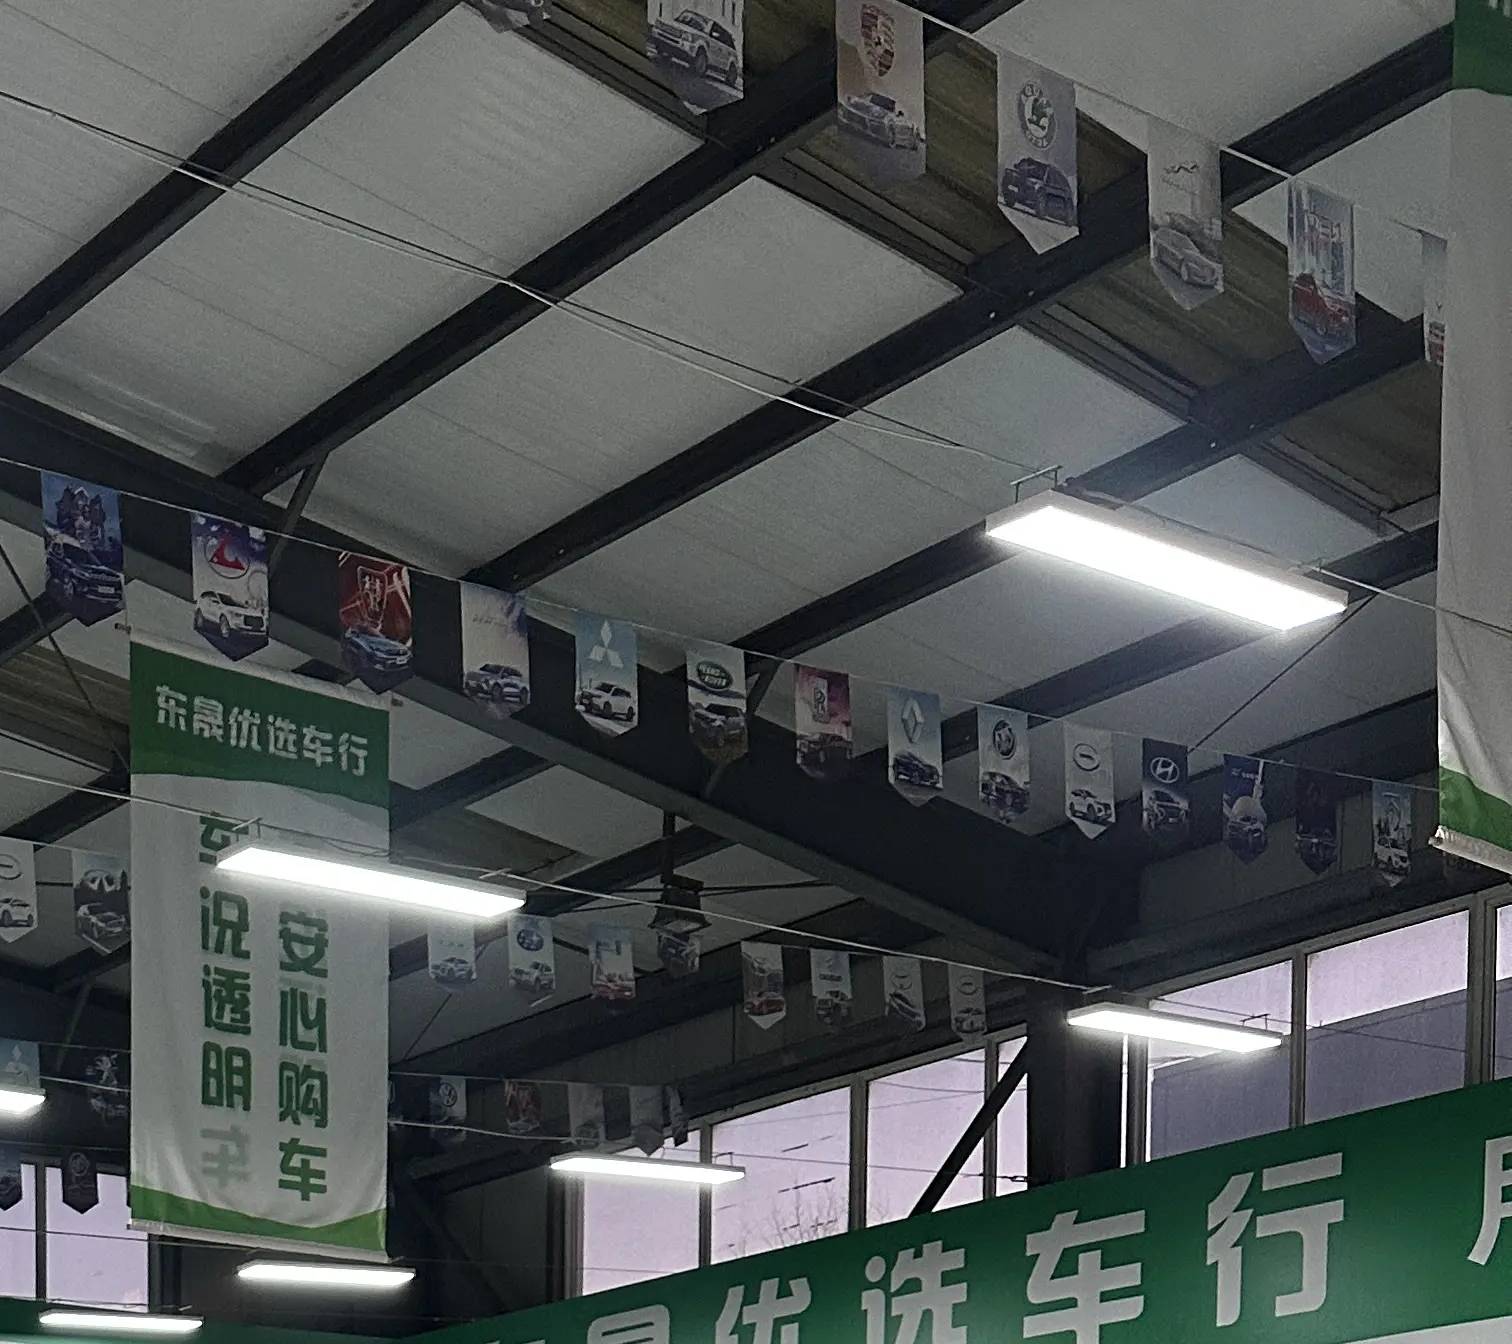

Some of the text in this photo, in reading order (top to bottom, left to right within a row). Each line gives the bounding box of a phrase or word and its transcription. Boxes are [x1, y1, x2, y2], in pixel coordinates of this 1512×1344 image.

[155, 684, 369, 778] 东晟优选车行
[277, 909, 330, 1202] 安心购车
